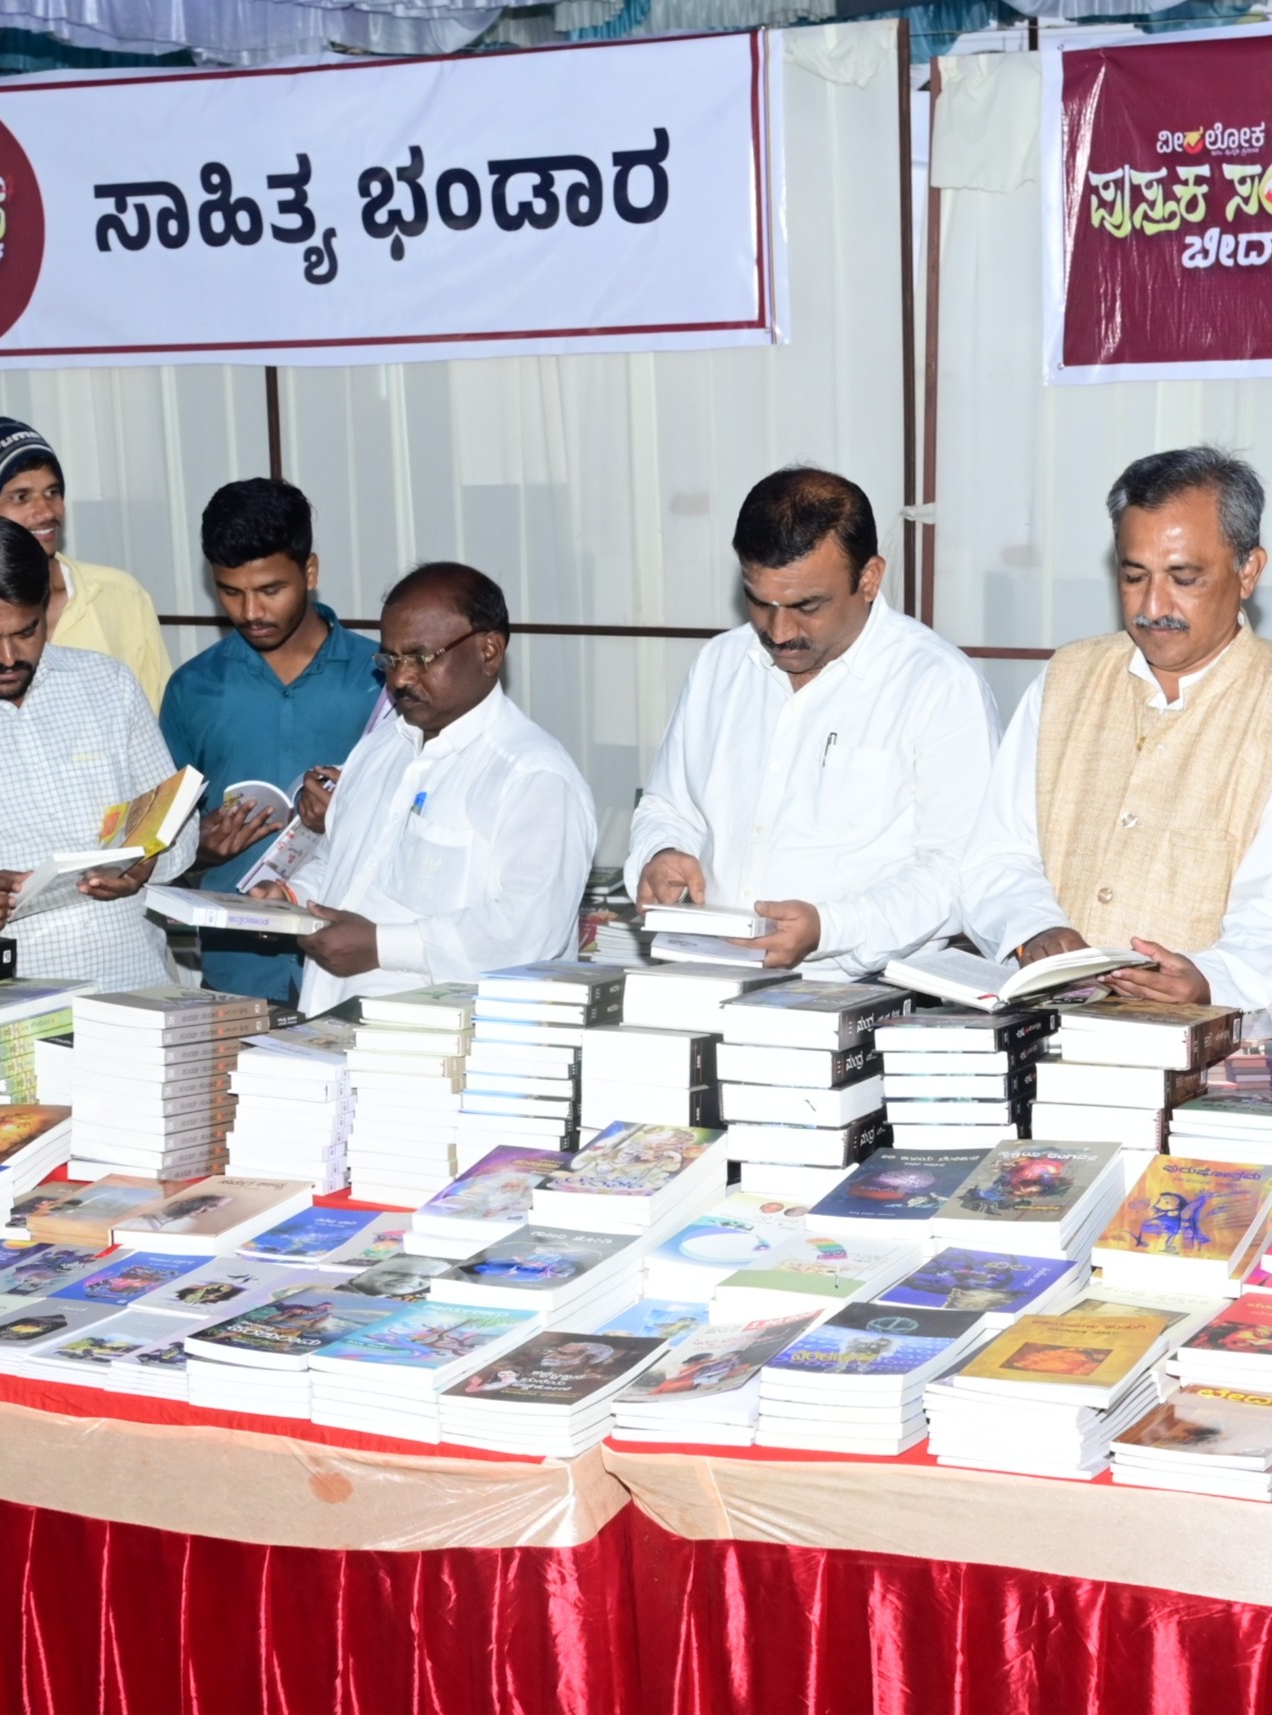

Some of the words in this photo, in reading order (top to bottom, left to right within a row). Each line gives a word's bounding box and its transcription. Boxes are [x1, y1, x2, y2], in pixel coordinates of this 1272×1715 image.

[93, 153, 338, 285] ಸಾಹಿತ್ಯ
[358, 127, 670, 262] ಭಂಡಾರ
[1088, 164, 1211, 238] ಪುಸ್ತಕ
